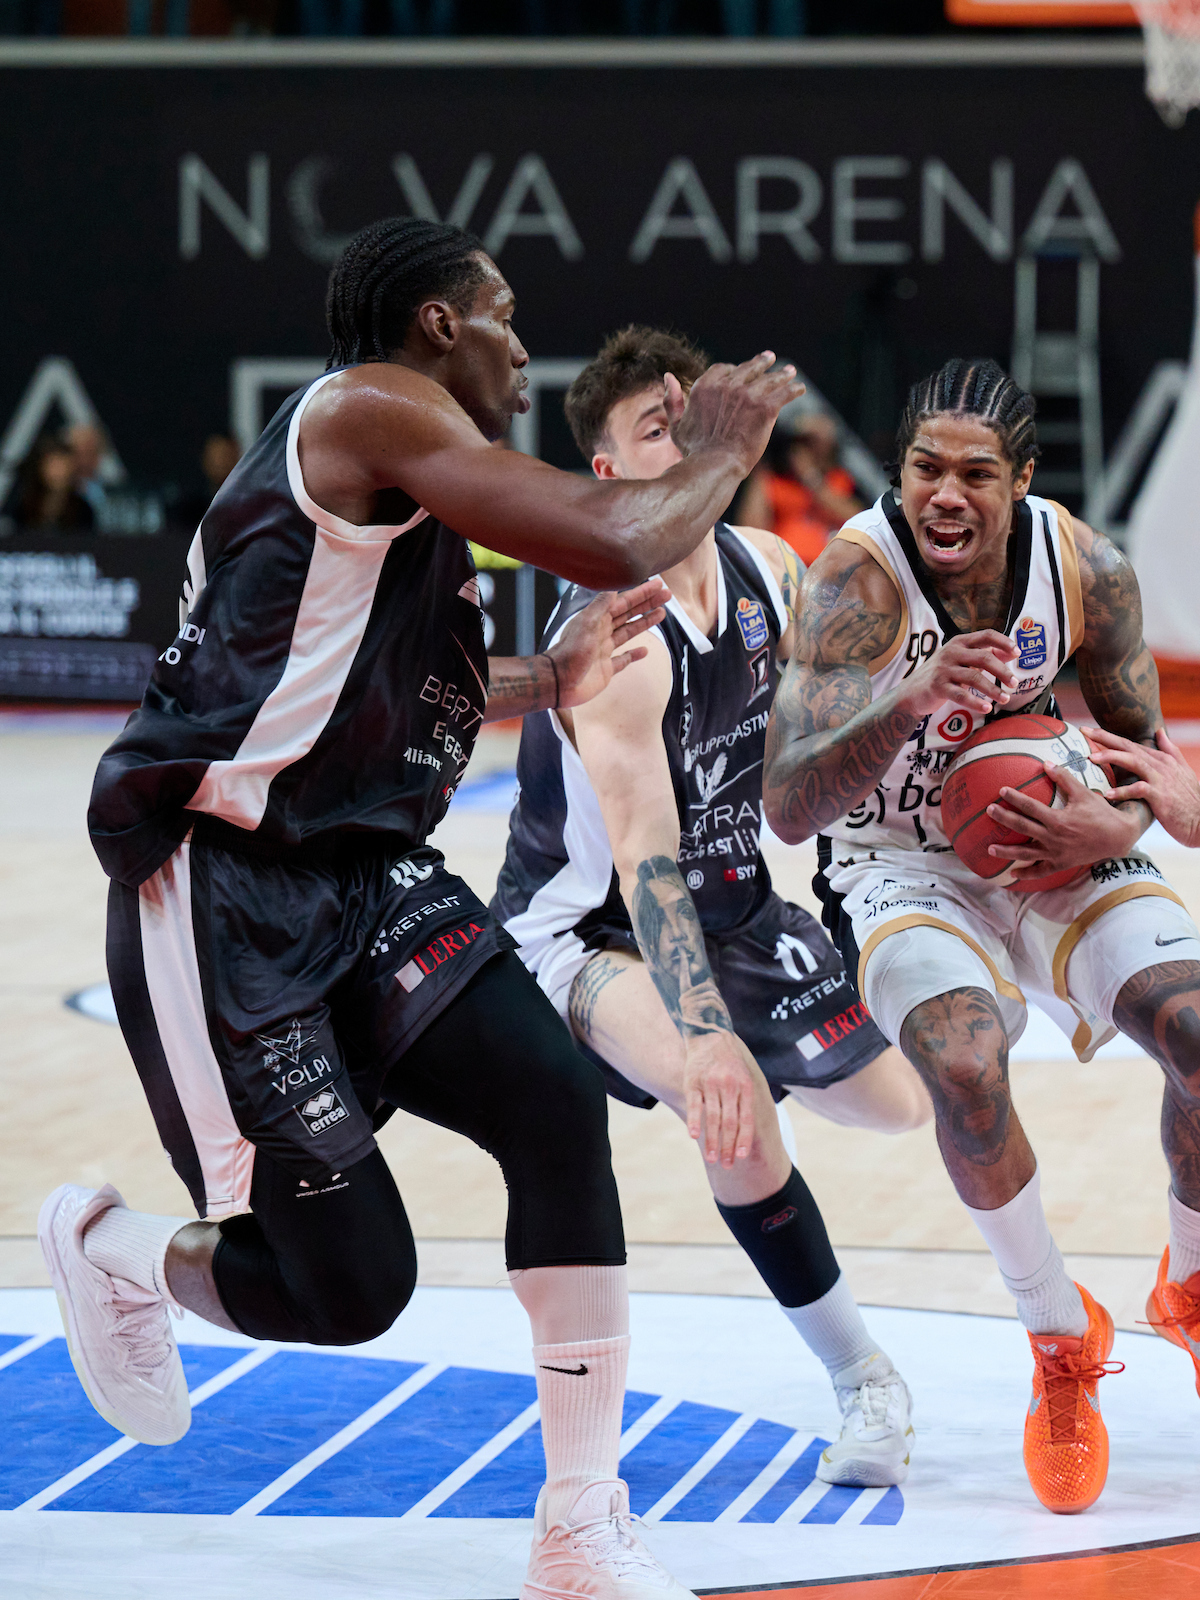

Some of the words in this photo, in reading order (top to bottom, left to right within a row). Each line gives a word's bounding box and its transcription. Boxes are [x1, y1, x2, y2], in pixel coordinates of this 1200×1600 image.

[629, 154, 1122, 264] ARENA
[744, 616, 764, 632] LBA
[1020, 638, 1044, 650] LBA
[1024, 654, 1043, 666] Unipol
[734, 710, 769, 742] ASTM
[1121, 857, 1162, 875] ITA
[390, 895, 461, 942] RETELIT
[413, 922, 486, 976] LERTA
[812, 1001, 872, 1051] LERTA
[271, 1054, 332, 1096] VOLPI
